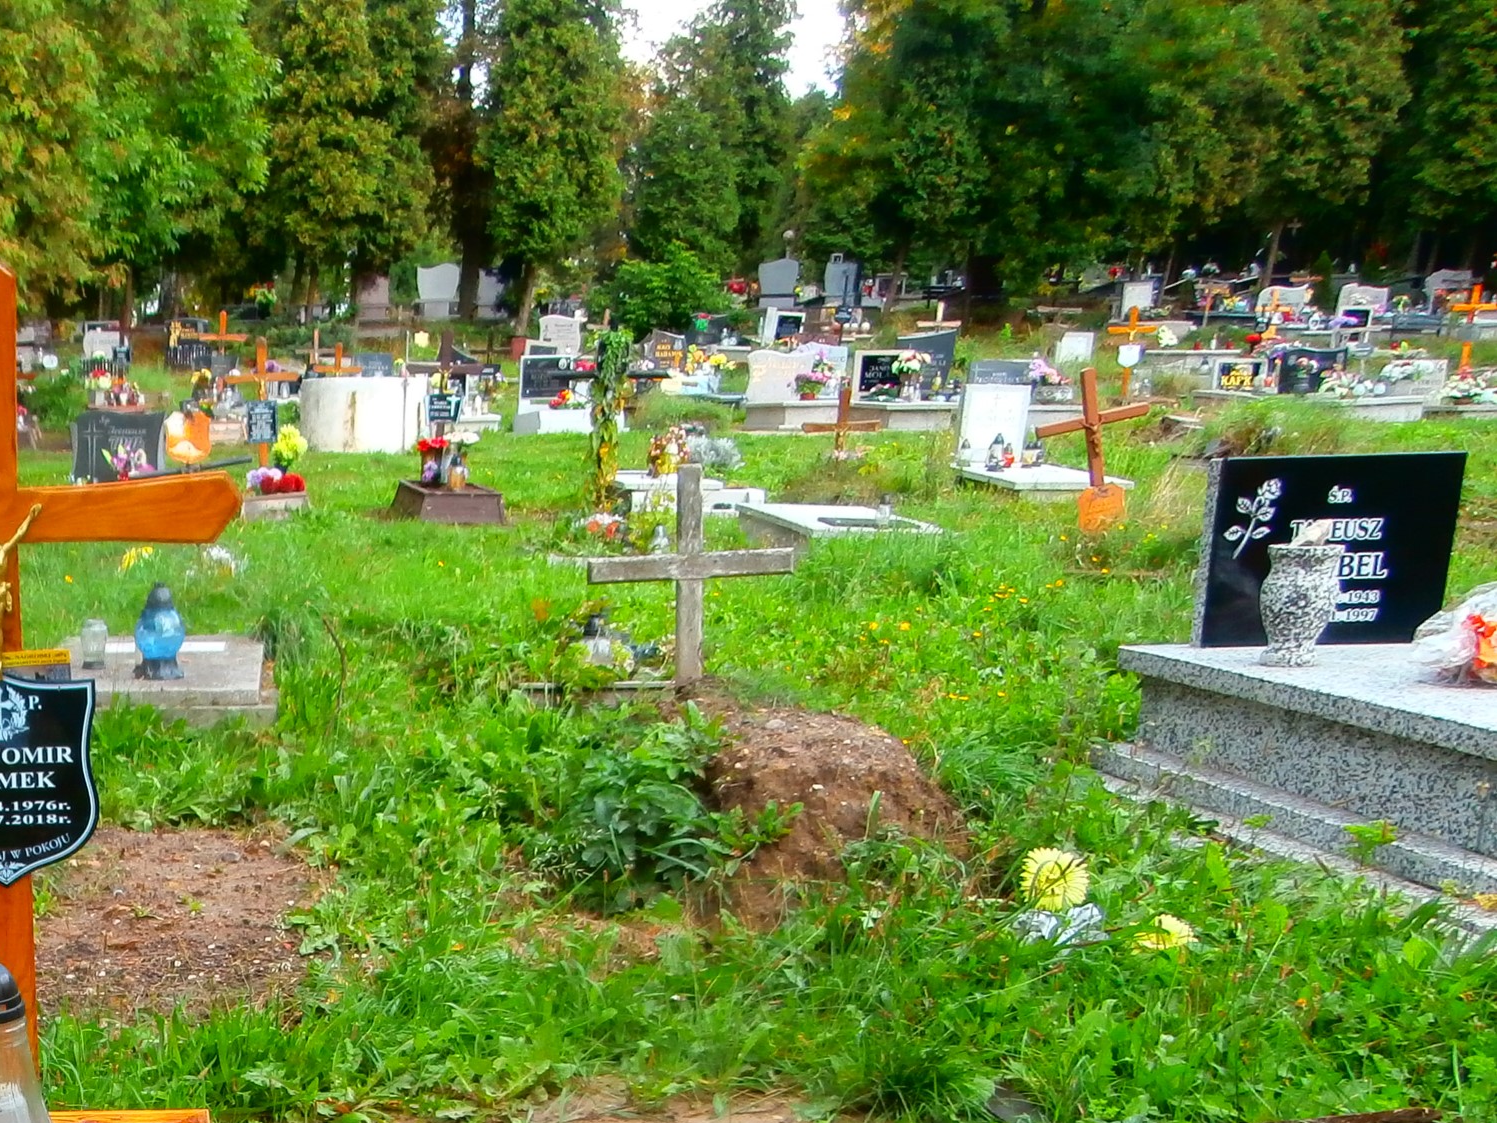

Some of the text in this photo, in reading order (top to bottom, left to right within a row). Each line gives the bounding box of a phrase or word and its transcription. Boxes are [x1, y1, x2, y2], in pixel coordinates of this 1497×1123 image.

[1290, 518, 1384, 541] TEUSZ
[1336, 552, 1389, 579] BEL
[1346, 608, 1378, 622] 1997
[10, 849, 21, 859] W
[25, 832, 71, 857] POKOJU
